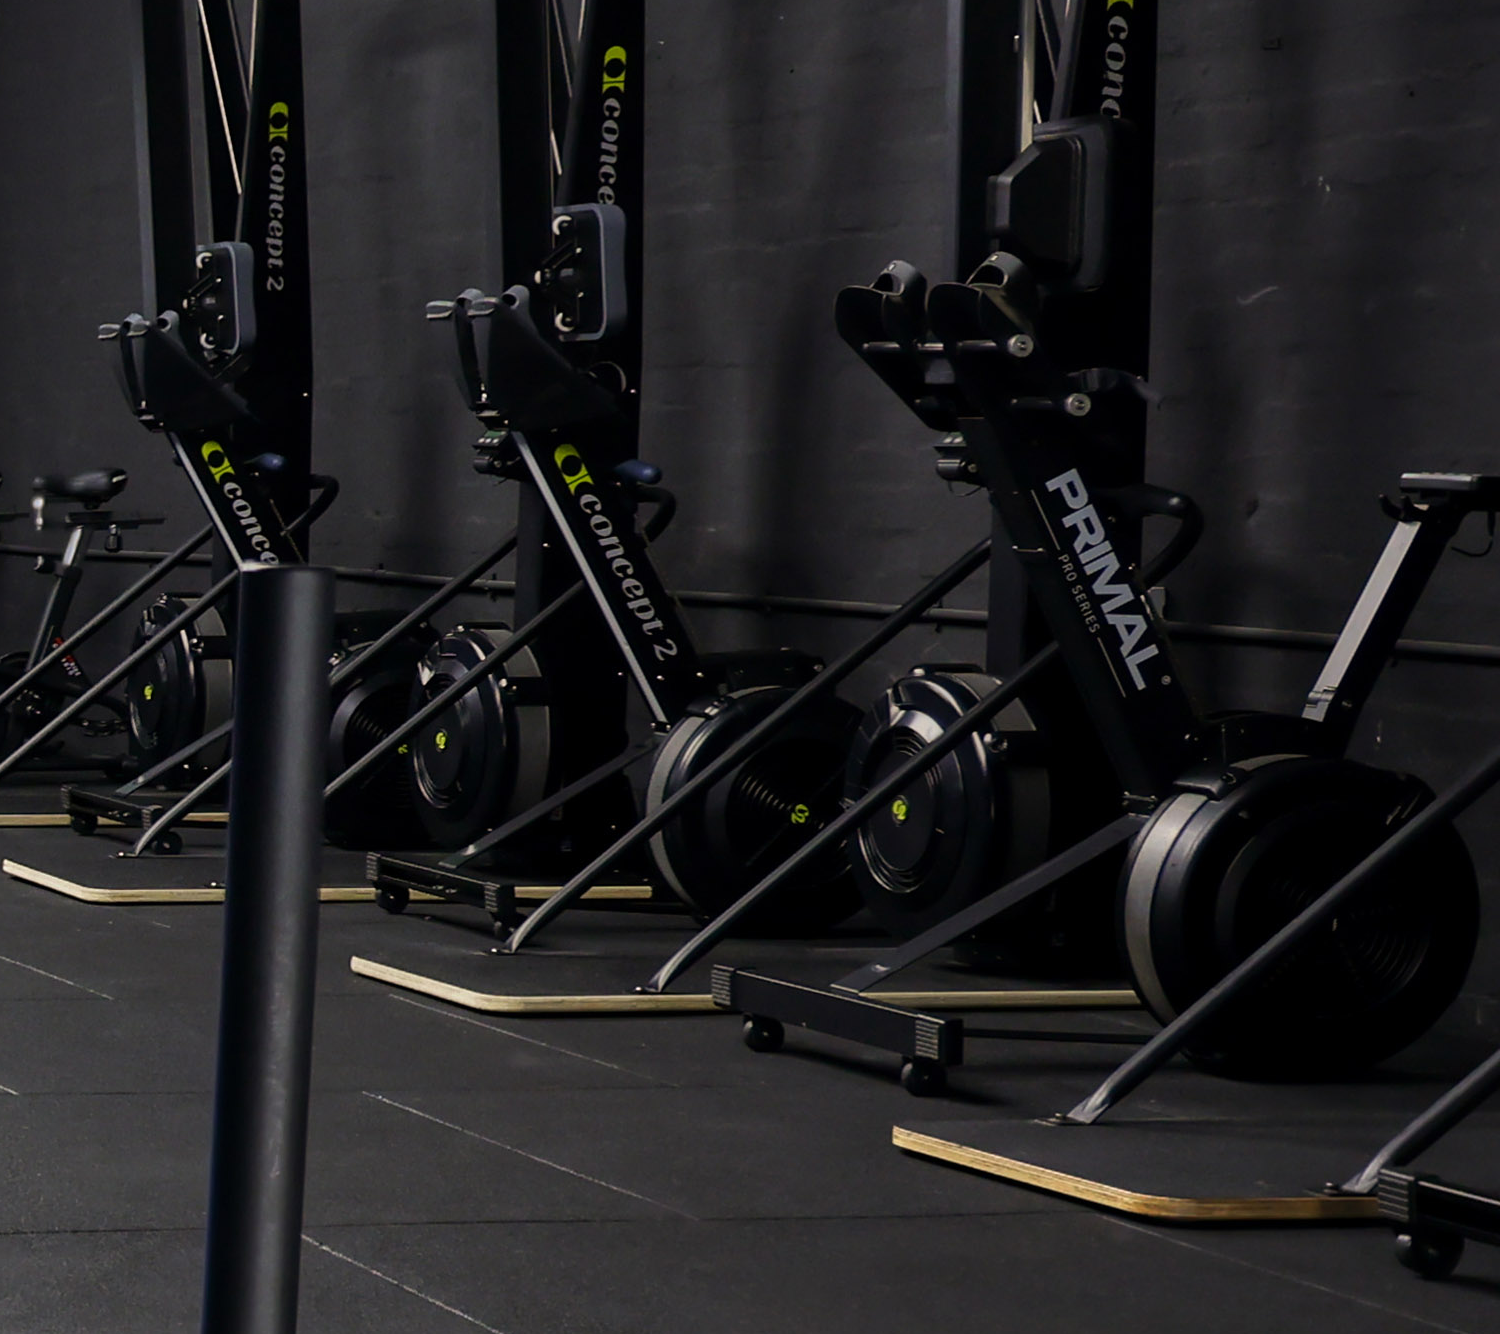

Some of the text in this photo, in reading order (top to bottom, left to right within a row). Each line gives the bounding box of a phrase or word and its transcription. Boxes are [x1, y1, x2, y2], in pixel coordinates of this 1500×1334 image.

[1101, 15, 1129, 119] conc
[597, 97, 622, 204] conce
[266, 145, 287, 292] concept 2
[222, 480, 279, 566] conce
[578, 492, 679, 663] concept 2
[1044, 468, 1160, 691] PRIMAL
[1057, 552, 1101, 634] PRO SERIES
